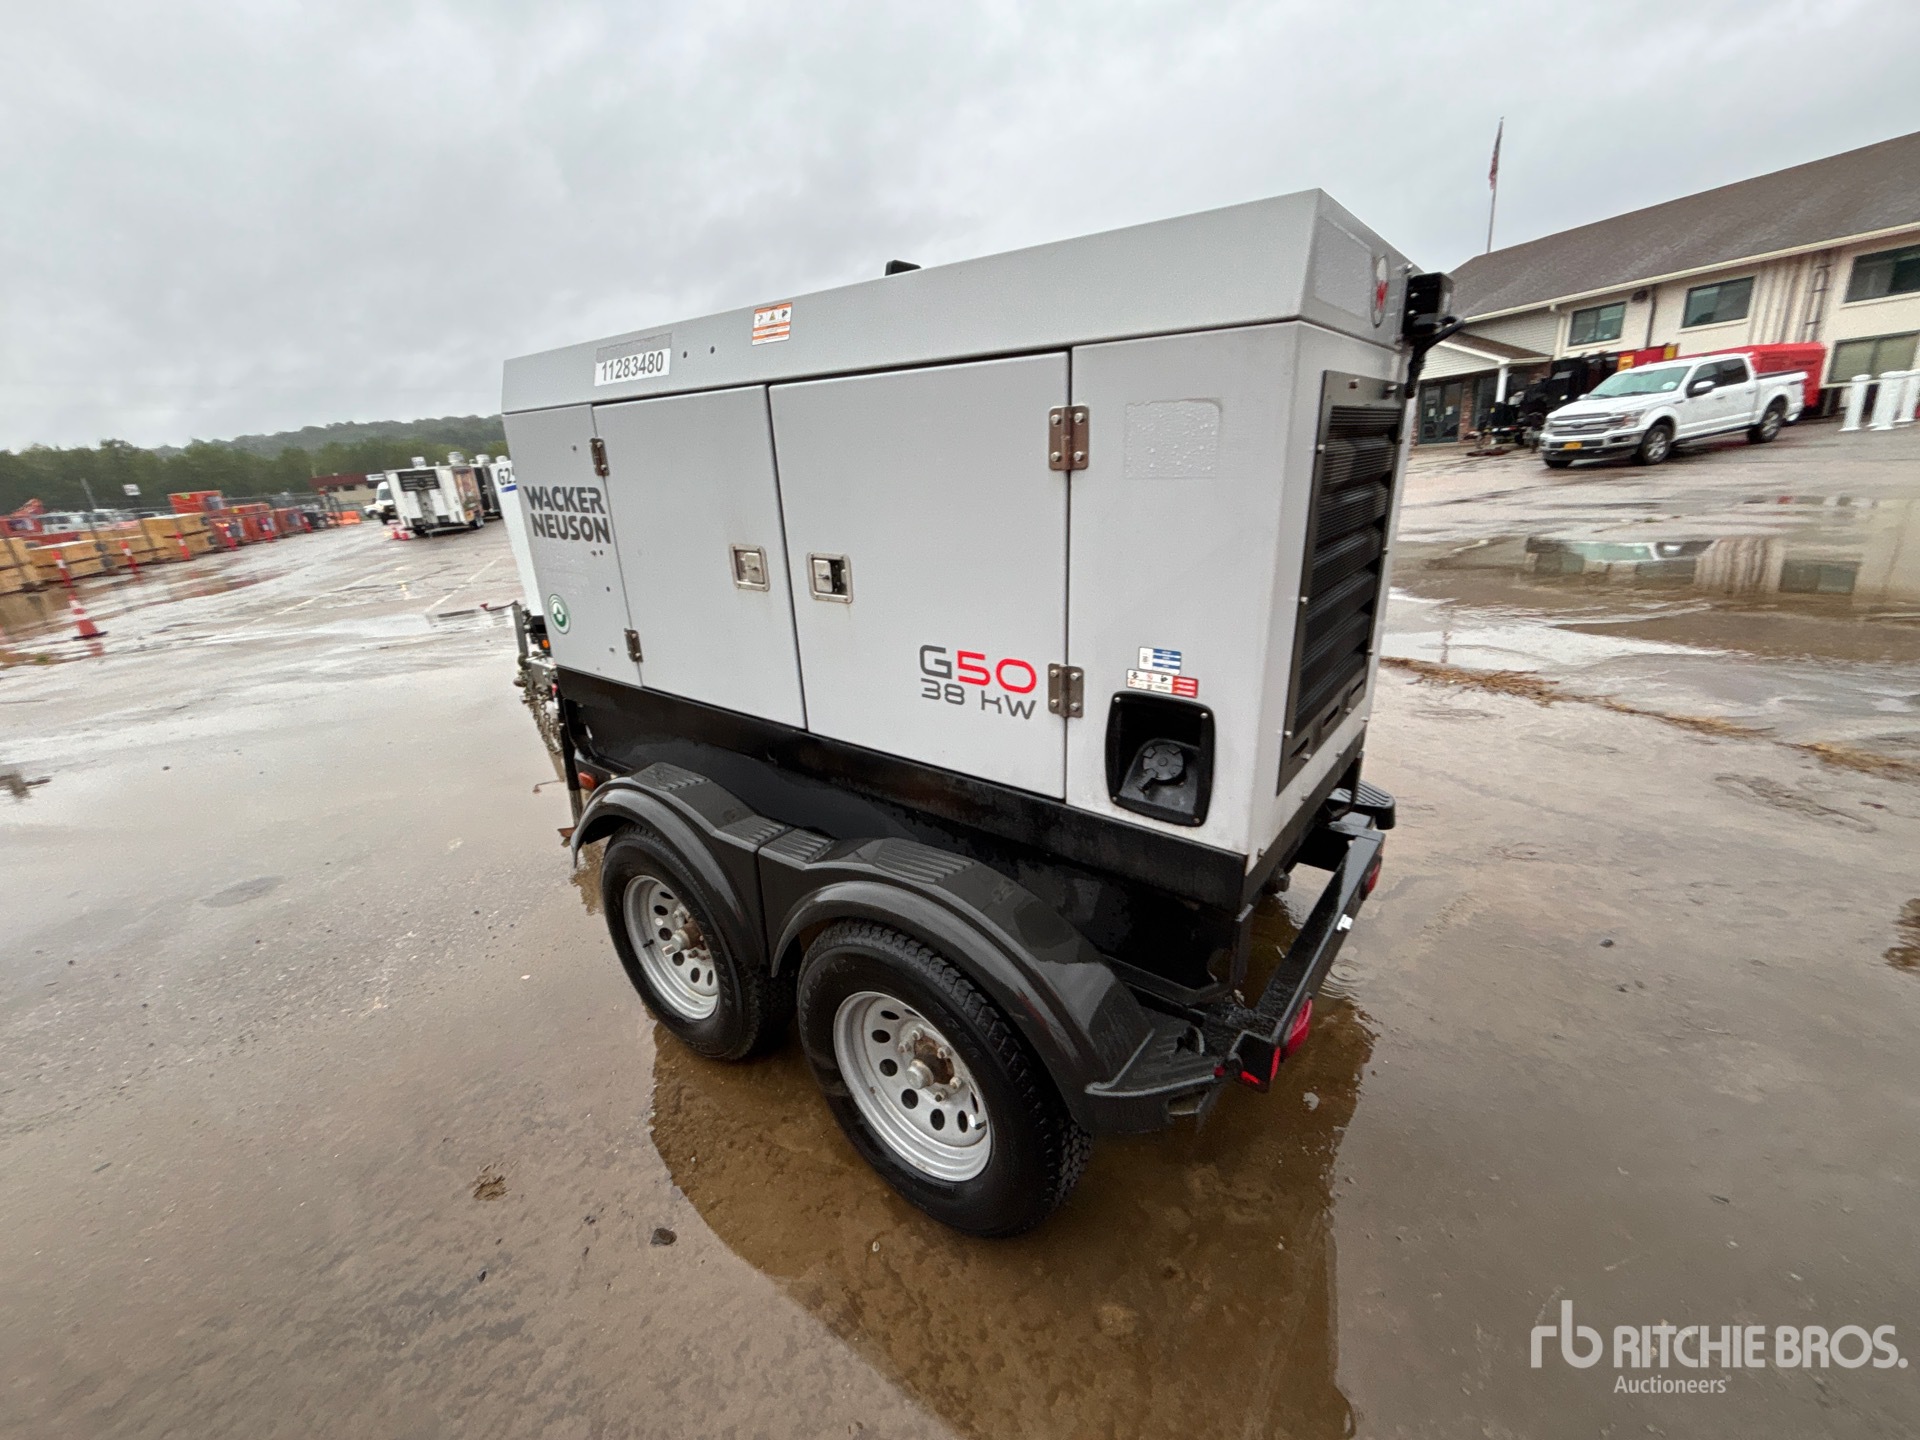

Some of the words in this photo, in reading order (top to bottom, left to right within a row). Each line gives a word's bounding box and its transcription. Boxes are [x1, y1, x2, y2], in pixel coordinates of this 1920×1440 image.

[602, 351, 664, 381] 11283480
[523, 486, 606, 514] WACKER
[530, 513, 611, 544] NEUSON
[919, 644, 1037, 694] G50
[920, 678, 965, 706] 38
